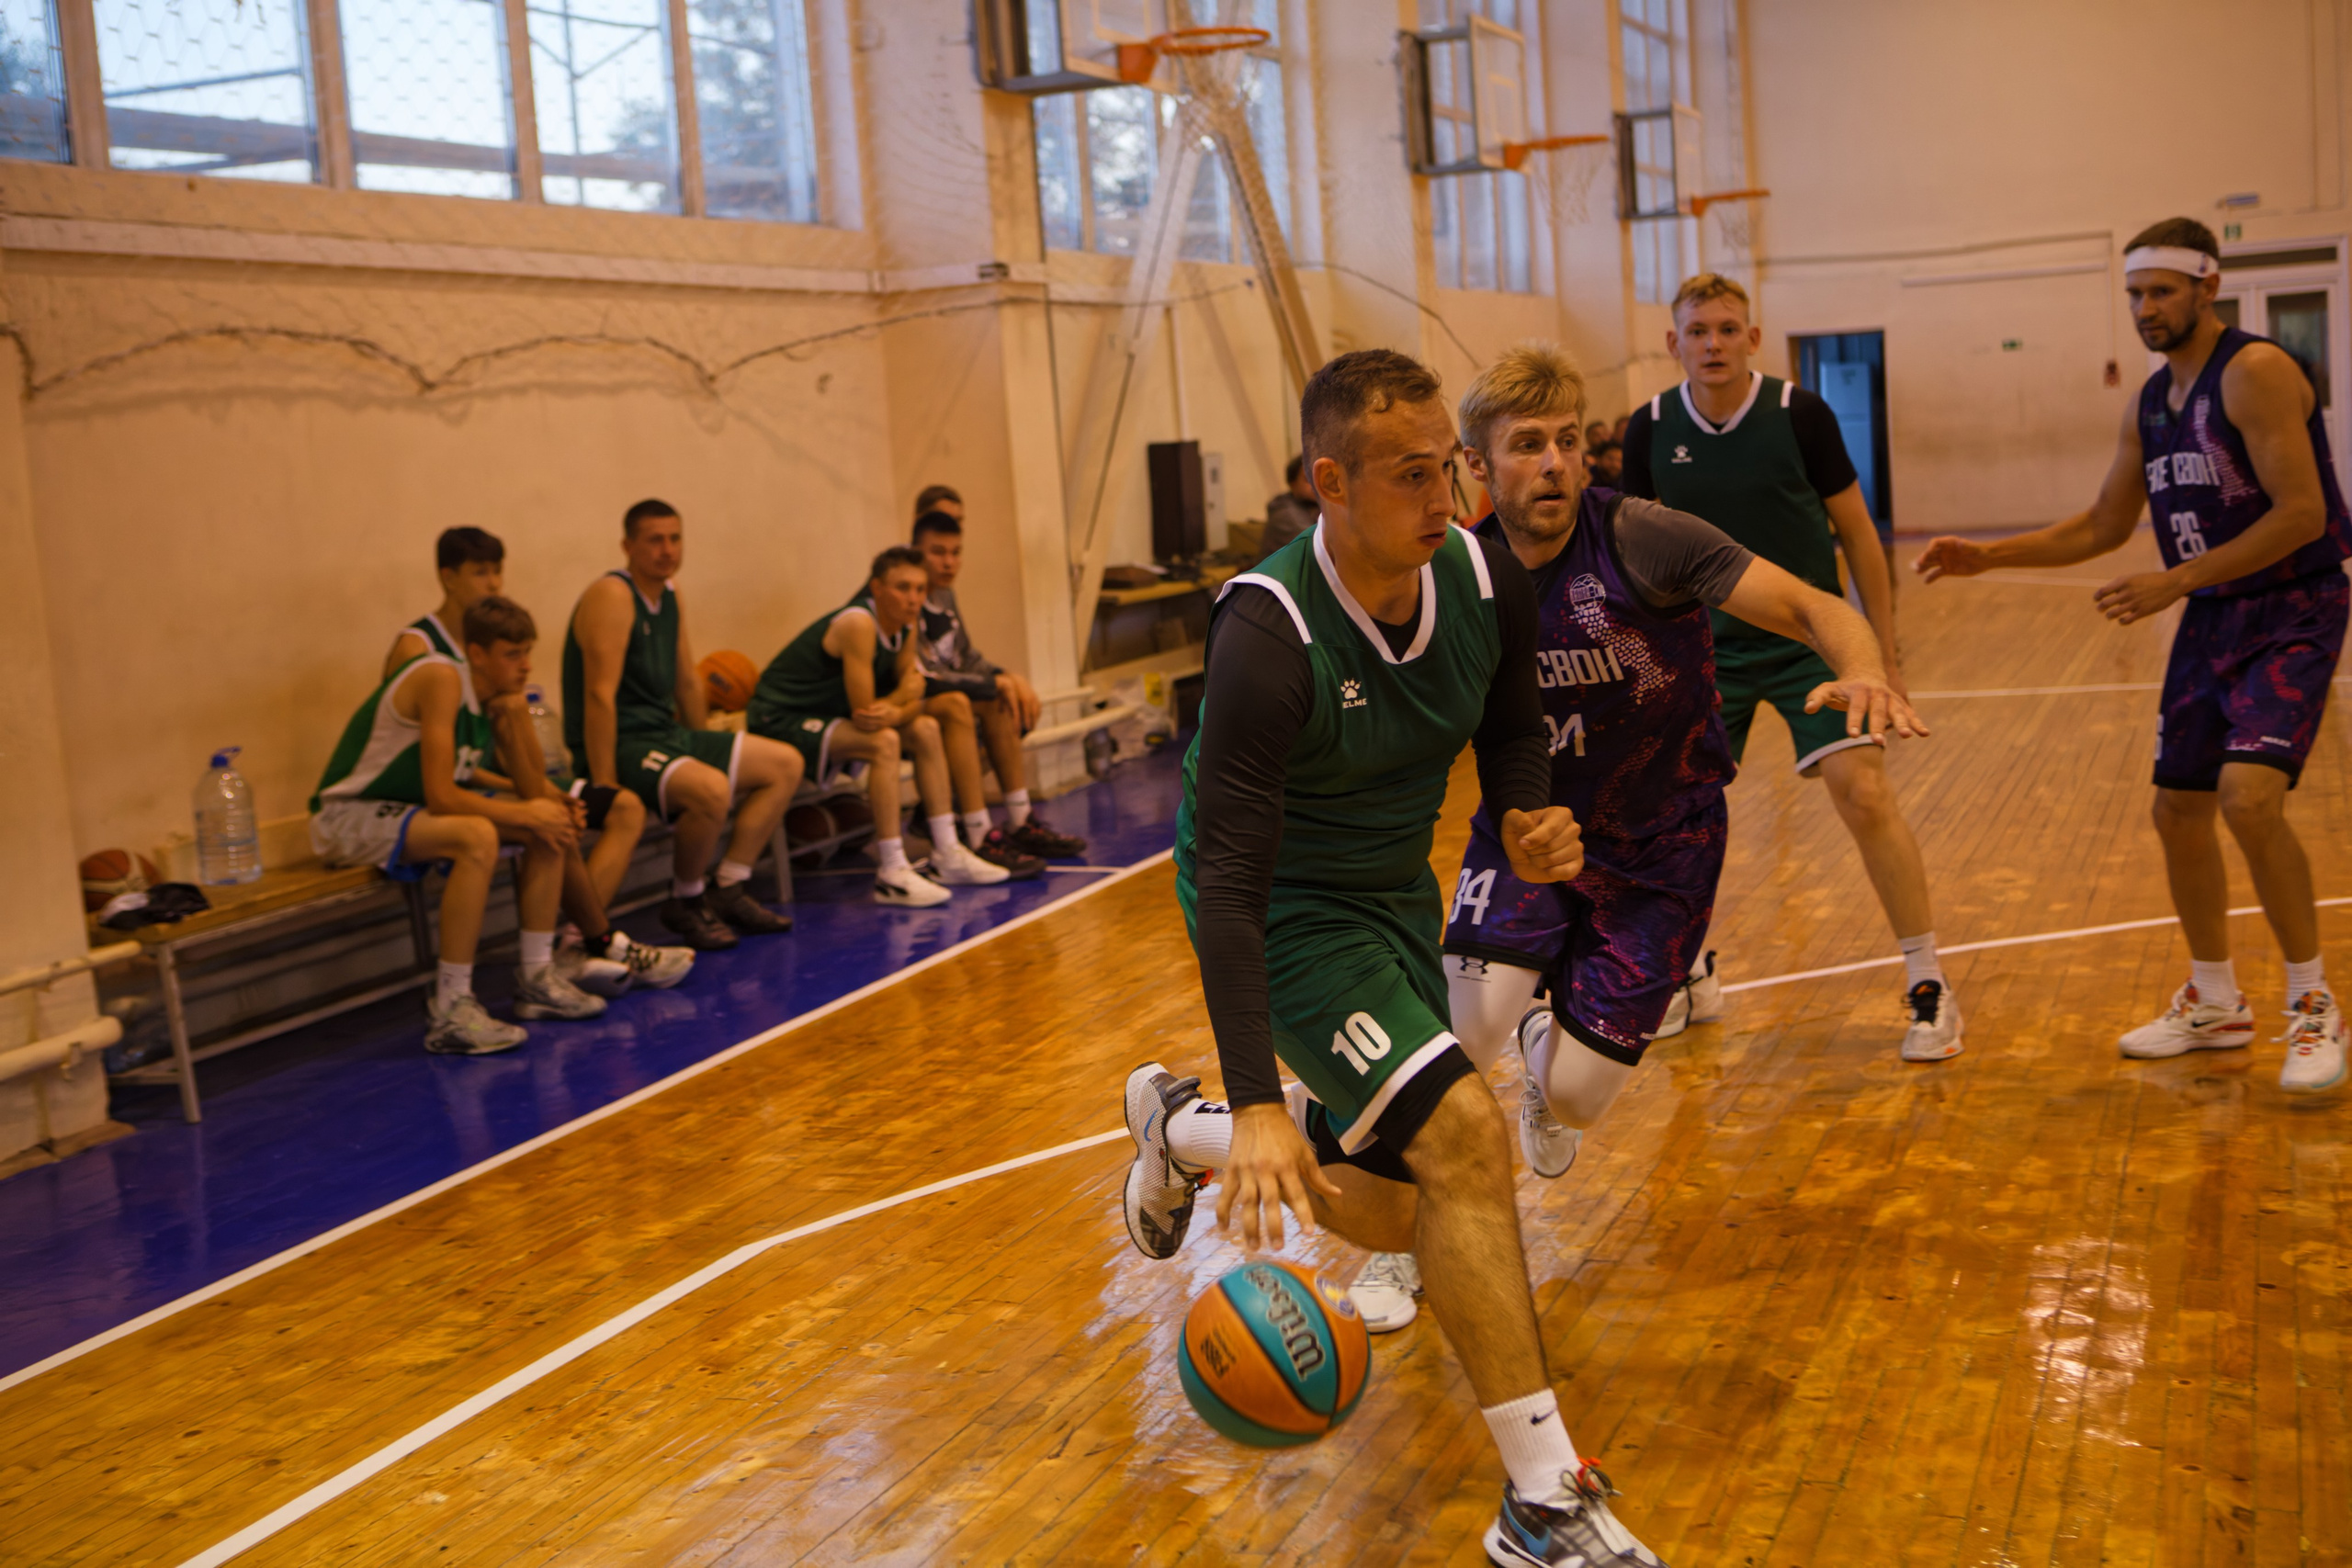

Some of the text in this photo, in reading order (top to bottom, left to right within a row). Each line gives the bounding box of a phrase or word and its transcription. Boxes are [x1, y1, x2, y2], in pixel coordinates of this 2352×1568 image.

[2169, 511, 2208, 560] 26
[1448, 867, 1498, 926] 34
[1330, 1010, 1392, 1077] 10
